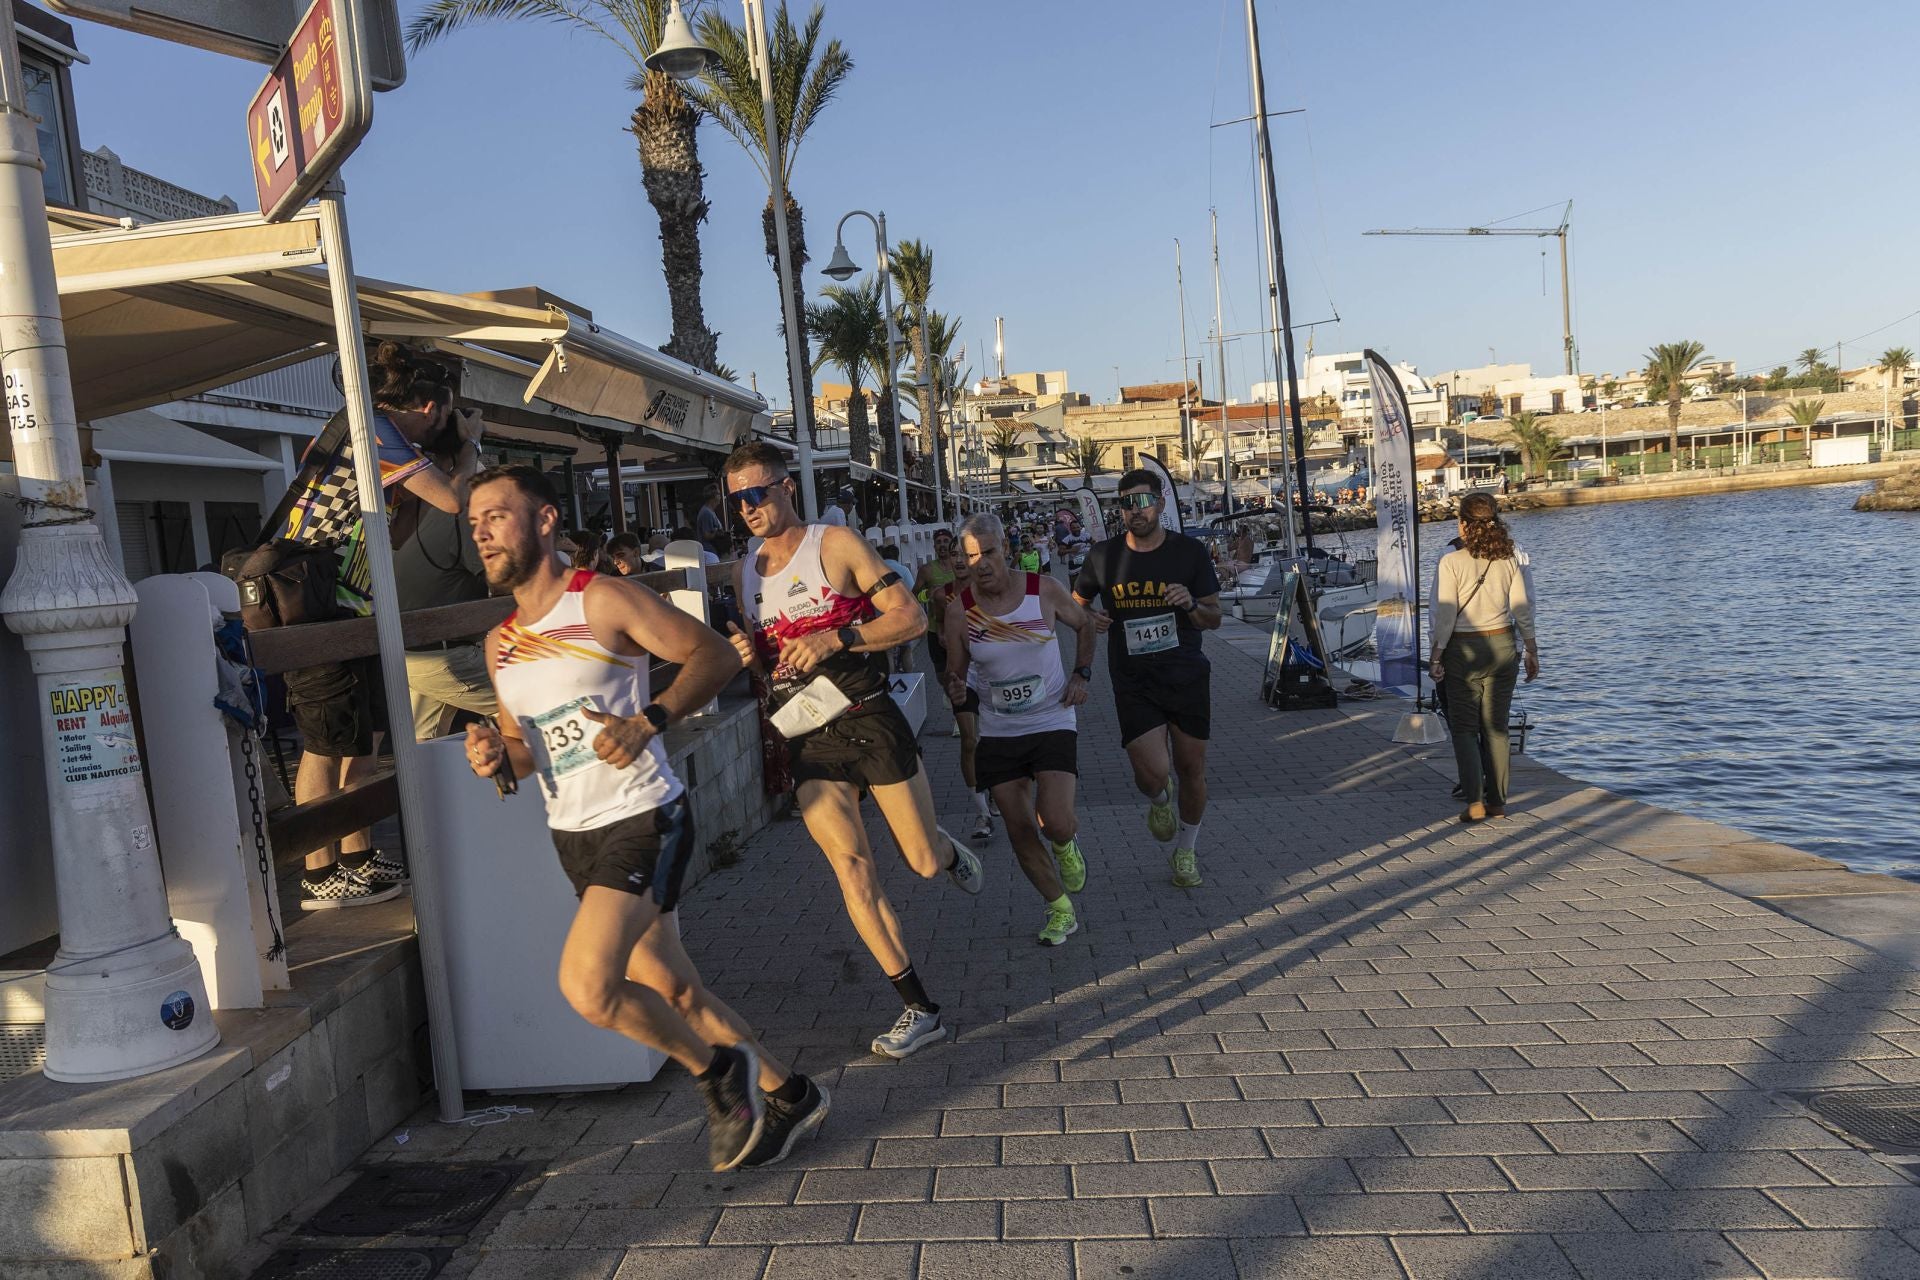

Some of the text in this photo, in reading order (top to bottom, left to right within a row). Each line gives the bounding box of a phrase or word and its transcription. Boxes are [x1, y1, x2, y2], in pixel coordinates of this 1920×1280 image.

[294, 42, 318, 92] Punto
[299, 84, 323, 135] limpio
[1115, 599, 1168, 609] UNIVERSIDA
[1135, 624, 1170, 642] 1418
[1002, 685, 1032, 702] 995
[57, 716, 86, 732] RENT
[63, 734, 87, 743] Motor
[65, 744, 92, 753] Sailing
[66, 755, 78, 763] Jet
[65, 773, 88, 783] CLUB
[91, 767, 128, 780] NAUTICO
[68, 763, 103, 774] Licencias
